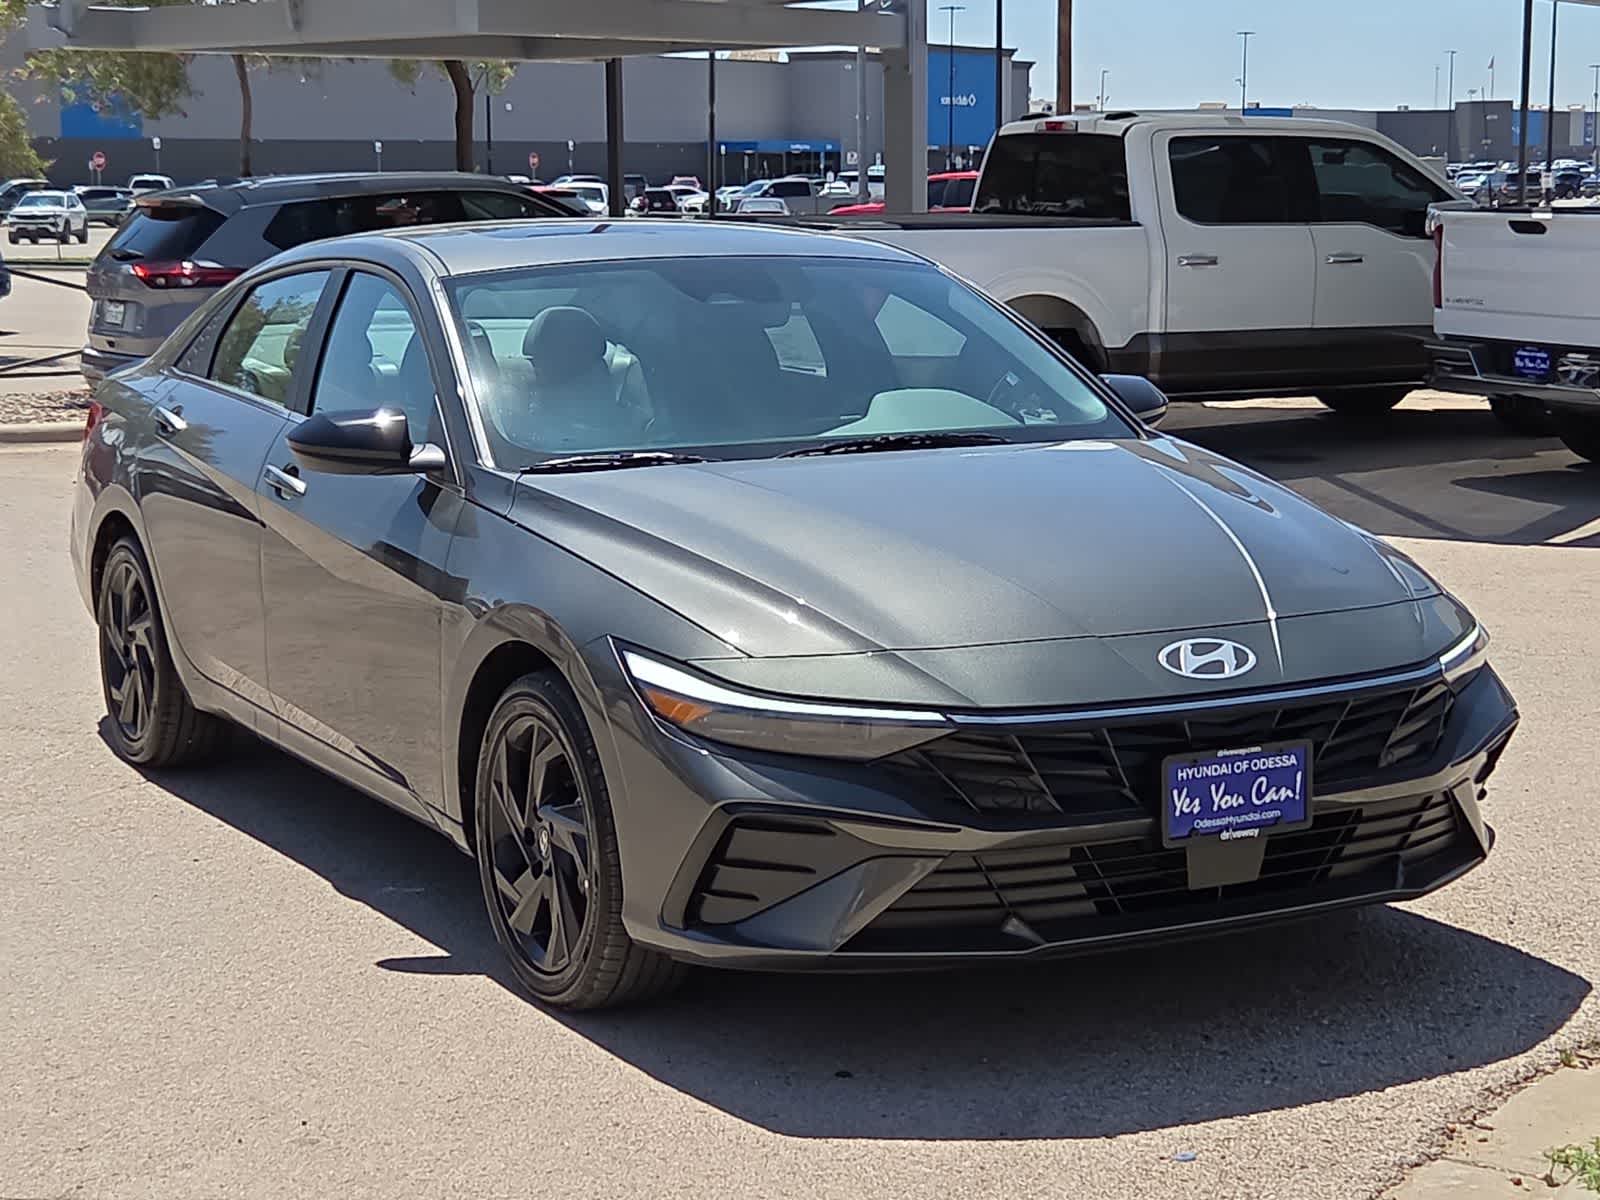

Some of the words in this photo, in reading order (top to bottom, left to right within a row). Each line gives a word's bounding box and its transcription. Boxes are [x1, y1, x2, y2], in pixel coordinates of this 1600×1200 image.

[1178, 764, 1231, 781] HYUNDAI
[1234, 760, 1249, 773] OF
[1251, 754, 1297, 771] ODESSA
[1173, 788, 1201, 816] Yes
[1211, 782, 1244, 812] You
[1252, 771, 1302, 805] Can!
[1193, 810, 1281, 829] OdessaHyundai.com
